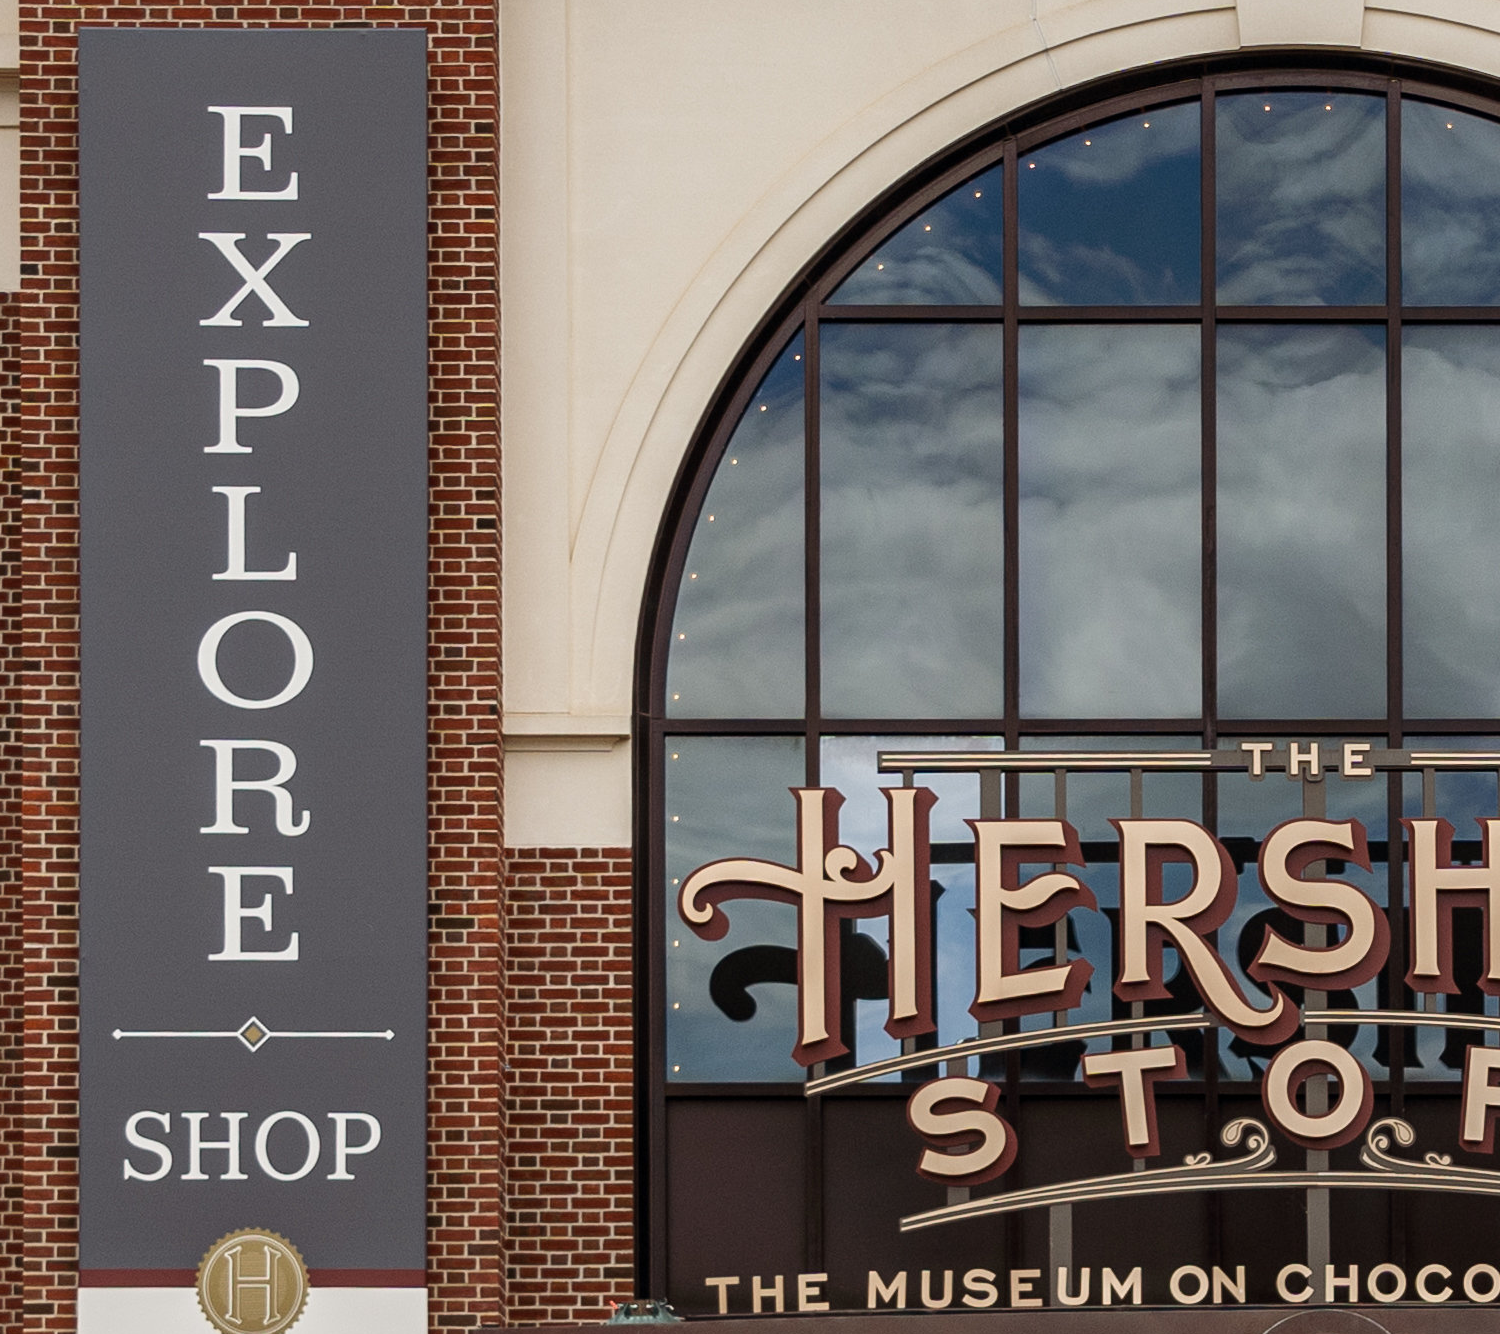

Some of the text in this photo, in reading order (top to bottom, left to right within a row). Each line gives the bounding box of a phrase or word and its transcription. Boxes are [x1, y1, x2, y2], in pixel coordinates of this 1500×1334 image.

[196, 104, 315, 962] EXPLORE
[1240, 741, 1372, 777] THE
[123, 1109, 383, 1183] SHOP
[704, 1272, 831, 1315] THE
[866, 1265, 1143, 1311] MUSEUM
[1168, 1264, 1247, 1306] ON
